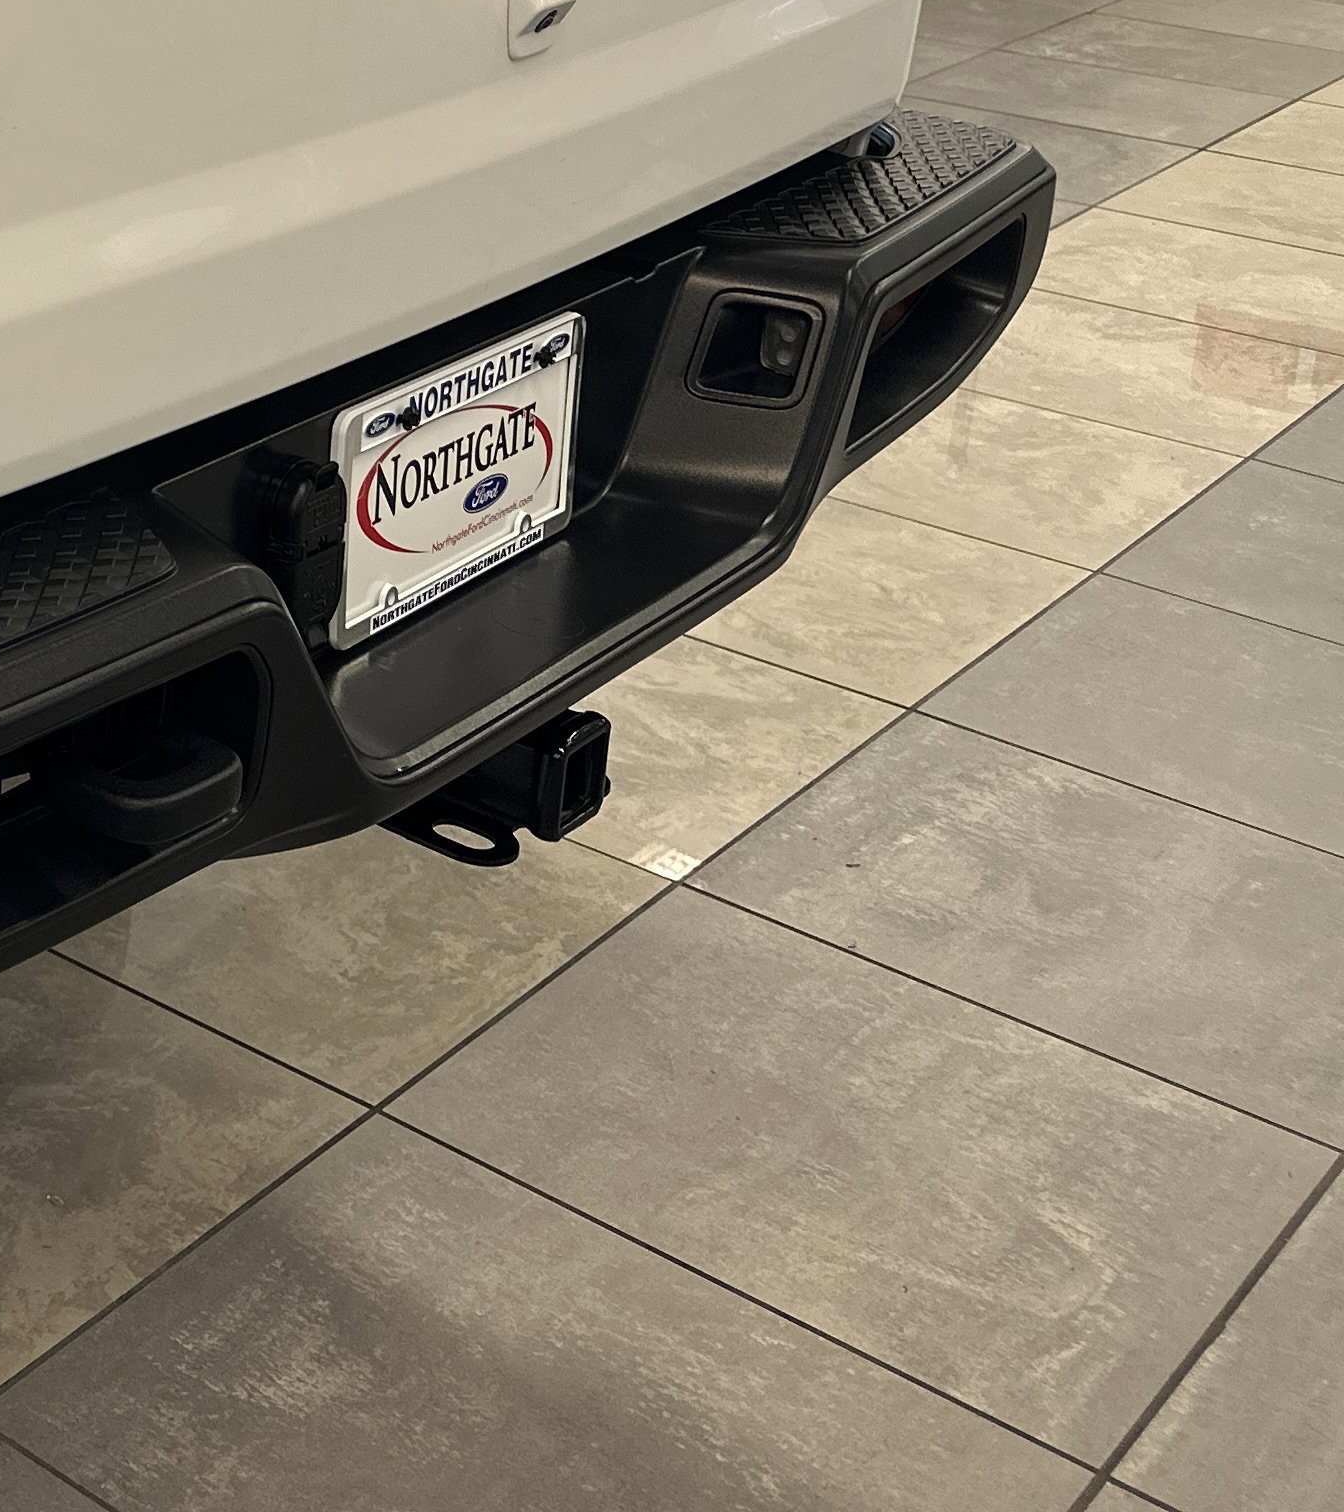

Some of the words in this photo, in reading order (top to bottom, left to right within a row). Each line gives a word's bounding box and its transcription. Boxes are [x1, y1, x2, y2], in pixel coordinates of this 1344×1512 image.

[409, 343, 534, 420] NORTHGATE
[368, 414, 393, 436] Ford
[371, 401, 538, 526] NORTHGATE
[468, 477, 503, 510] Ford
